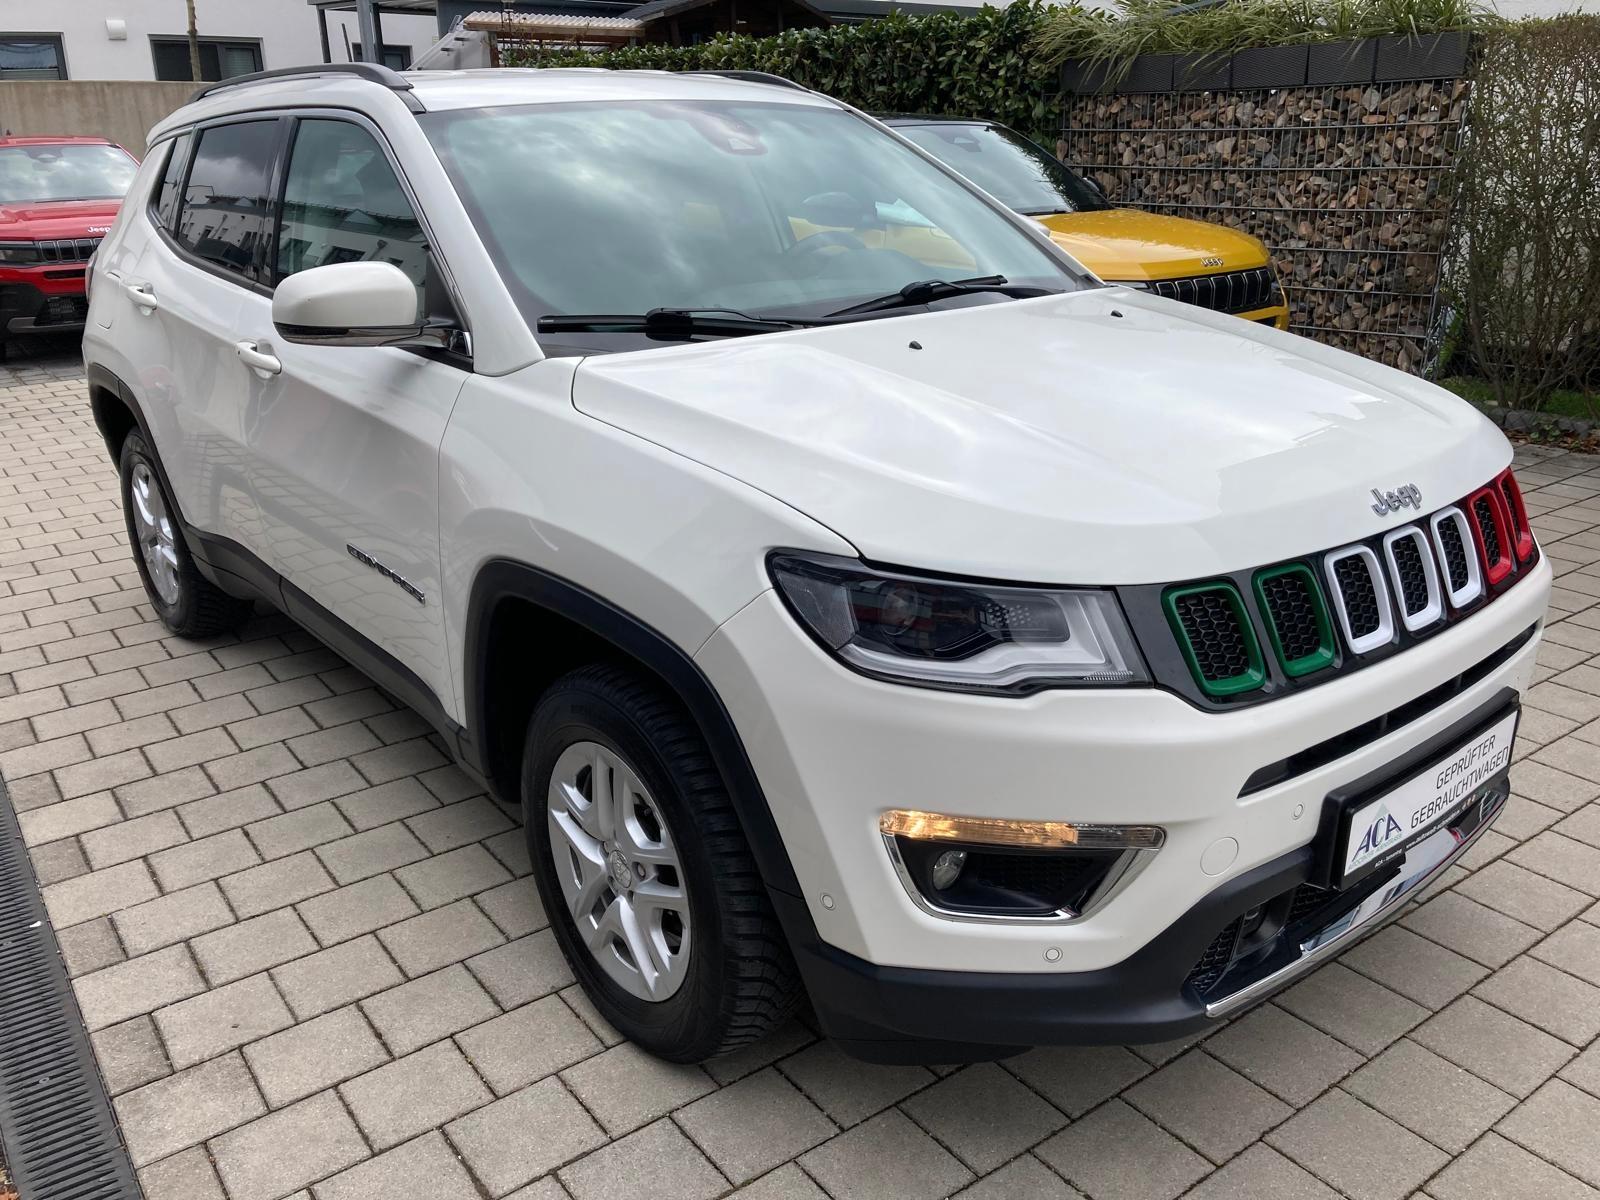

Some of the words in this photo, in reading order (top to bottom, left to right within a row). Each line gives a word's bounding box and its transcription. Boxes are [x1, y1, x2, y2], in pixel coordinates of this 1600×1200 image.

[1201, 256, 1223, 267] Jeep
[1370, 483, 1422, 517] Jeep
[1436, 734, 1496, 789] GEPRÜFTER
[1410, 745, 1509, 829] GEBRAUCHTWAGEN
[1351, 813, 1402, 862] ACA
